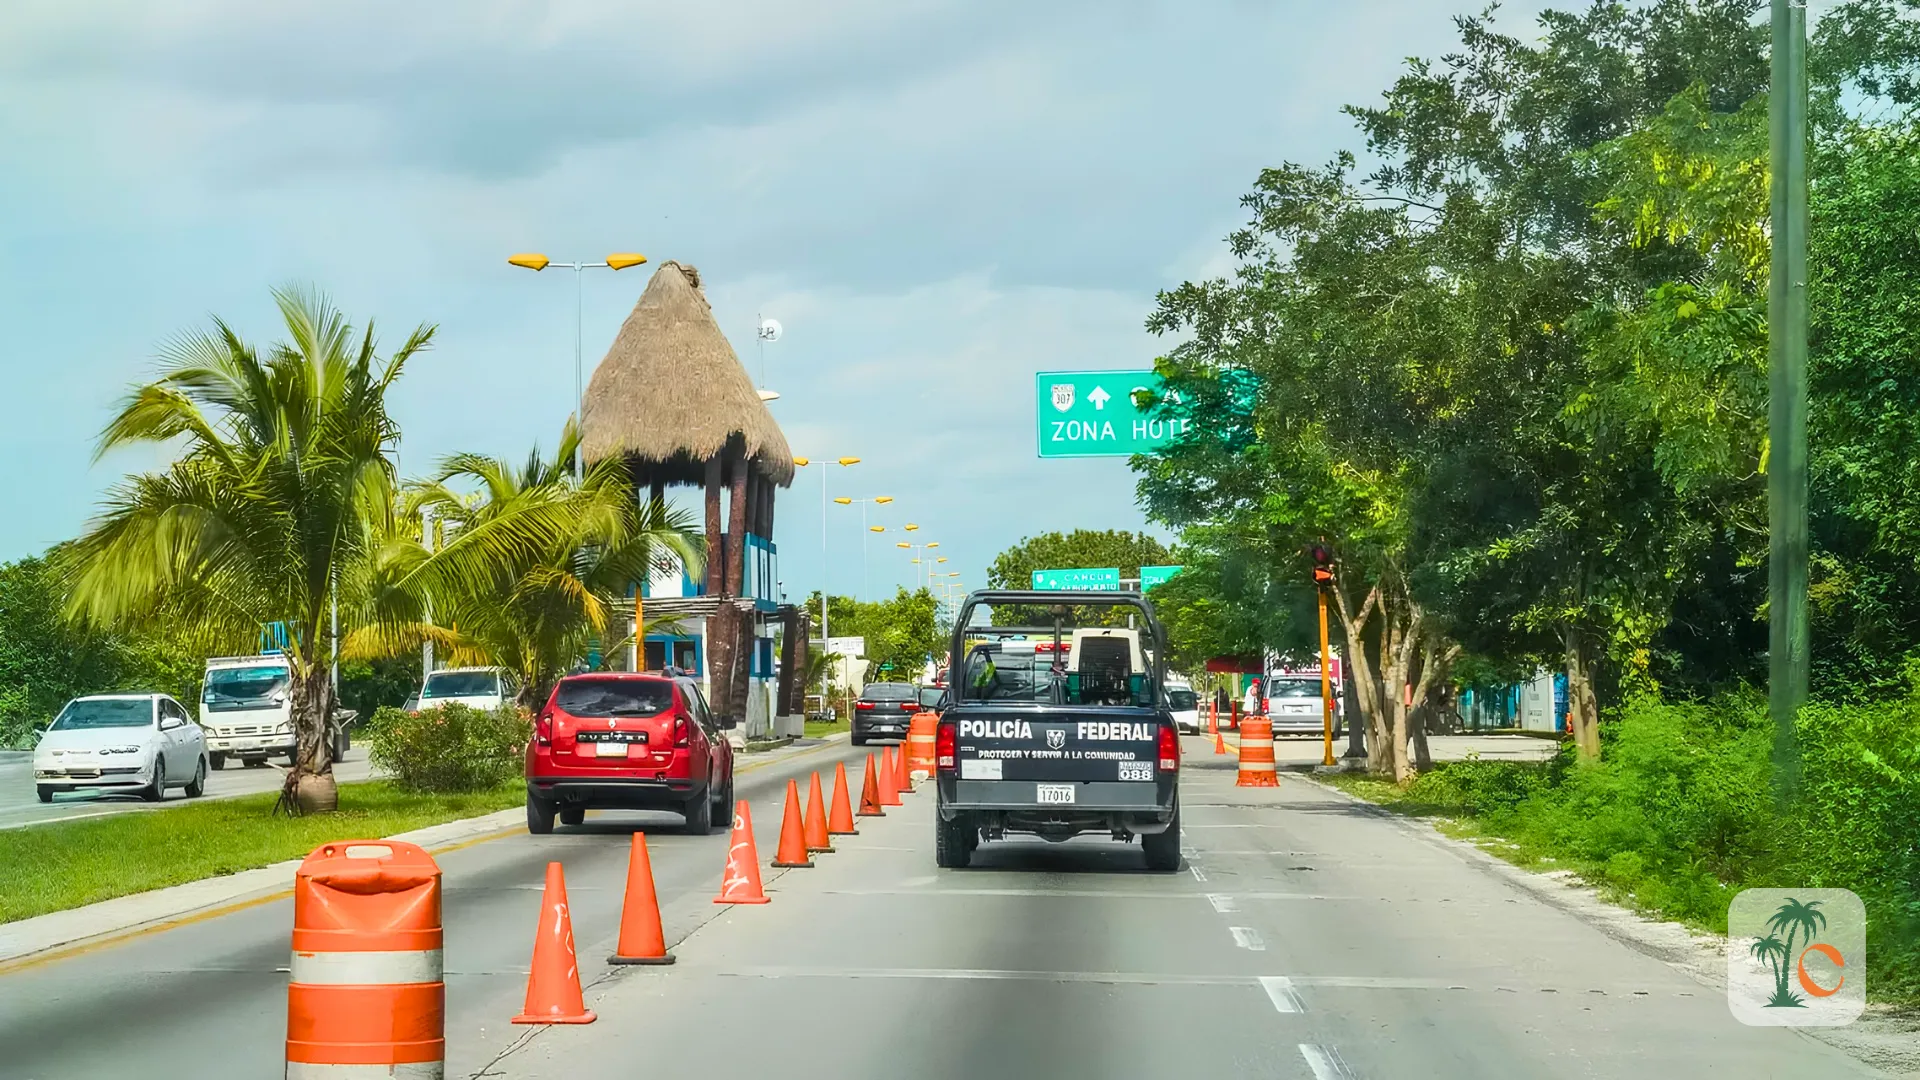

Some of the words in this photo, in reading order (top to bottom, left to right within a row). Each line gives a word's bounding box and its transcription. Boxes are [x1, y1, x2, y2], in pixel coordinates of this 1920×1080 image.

[1056, 393, 1071, 405] 307
[1051, 420, 1116, 441] ZONA
[1132, 419, 1198, 440] HOTE
[960, 719, 1033, 739] POLICÍA
[1077, 722, 1153, 741] FEDERAL
[978, 750, 1023, 759] PROTEGER
[1031, 750, 1062, 759] SERVIR
[1064, 751, 1070, 759] A
[1072, 751, 1082, 760] LA
[1084, 751, 1135, 760] COMUNIDAD
[1120, 769, 1151, 780] 088
[1042, 790, 1071, 802] 17016
